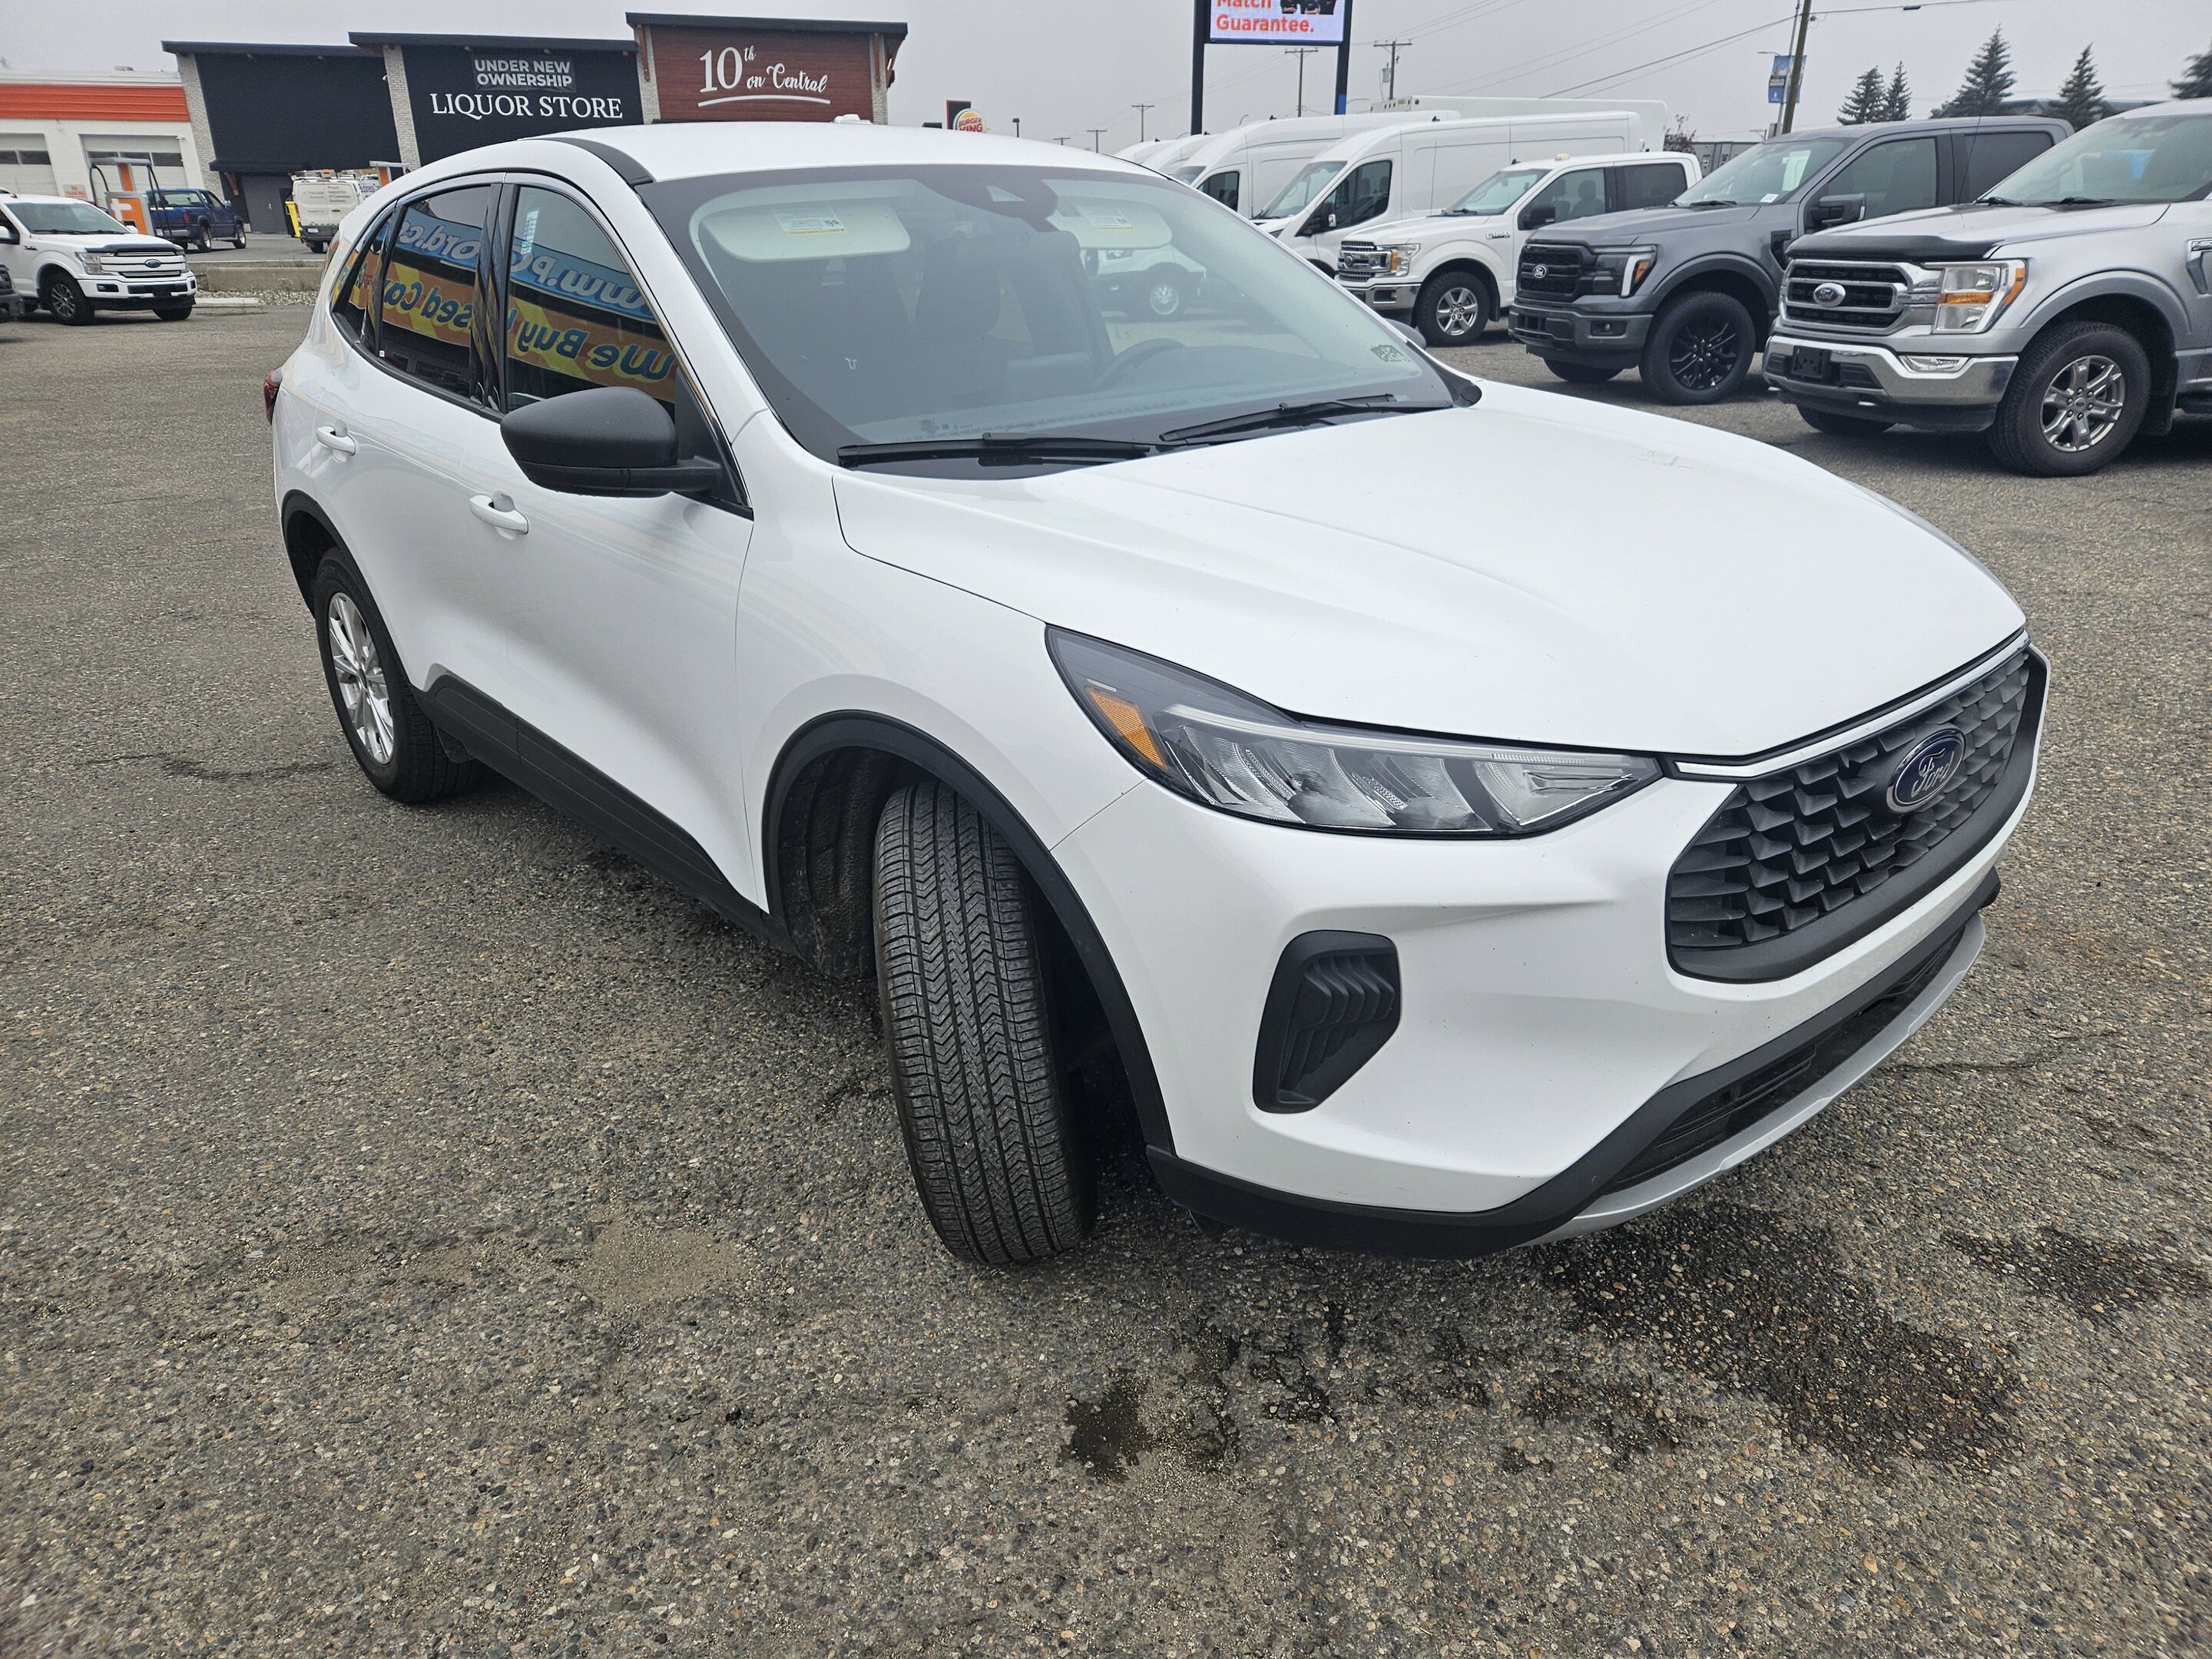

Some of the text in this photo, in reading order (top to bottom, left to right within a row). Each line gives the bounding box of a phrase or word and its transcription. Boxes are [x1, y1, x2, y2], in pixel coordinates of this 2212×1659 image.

[1217, 14, 1314, 32] Guarantee.
[474, 59, 571, 74] UNDER NEW
[747, 75, 765, 89] on
[767, 63, 828, 93] Central
[476, 74, 573, 88] OWNERSHIP
[429, 93, 623, 121] LIQUOR STORE
[1911, 748, 1955, 798] Ford
